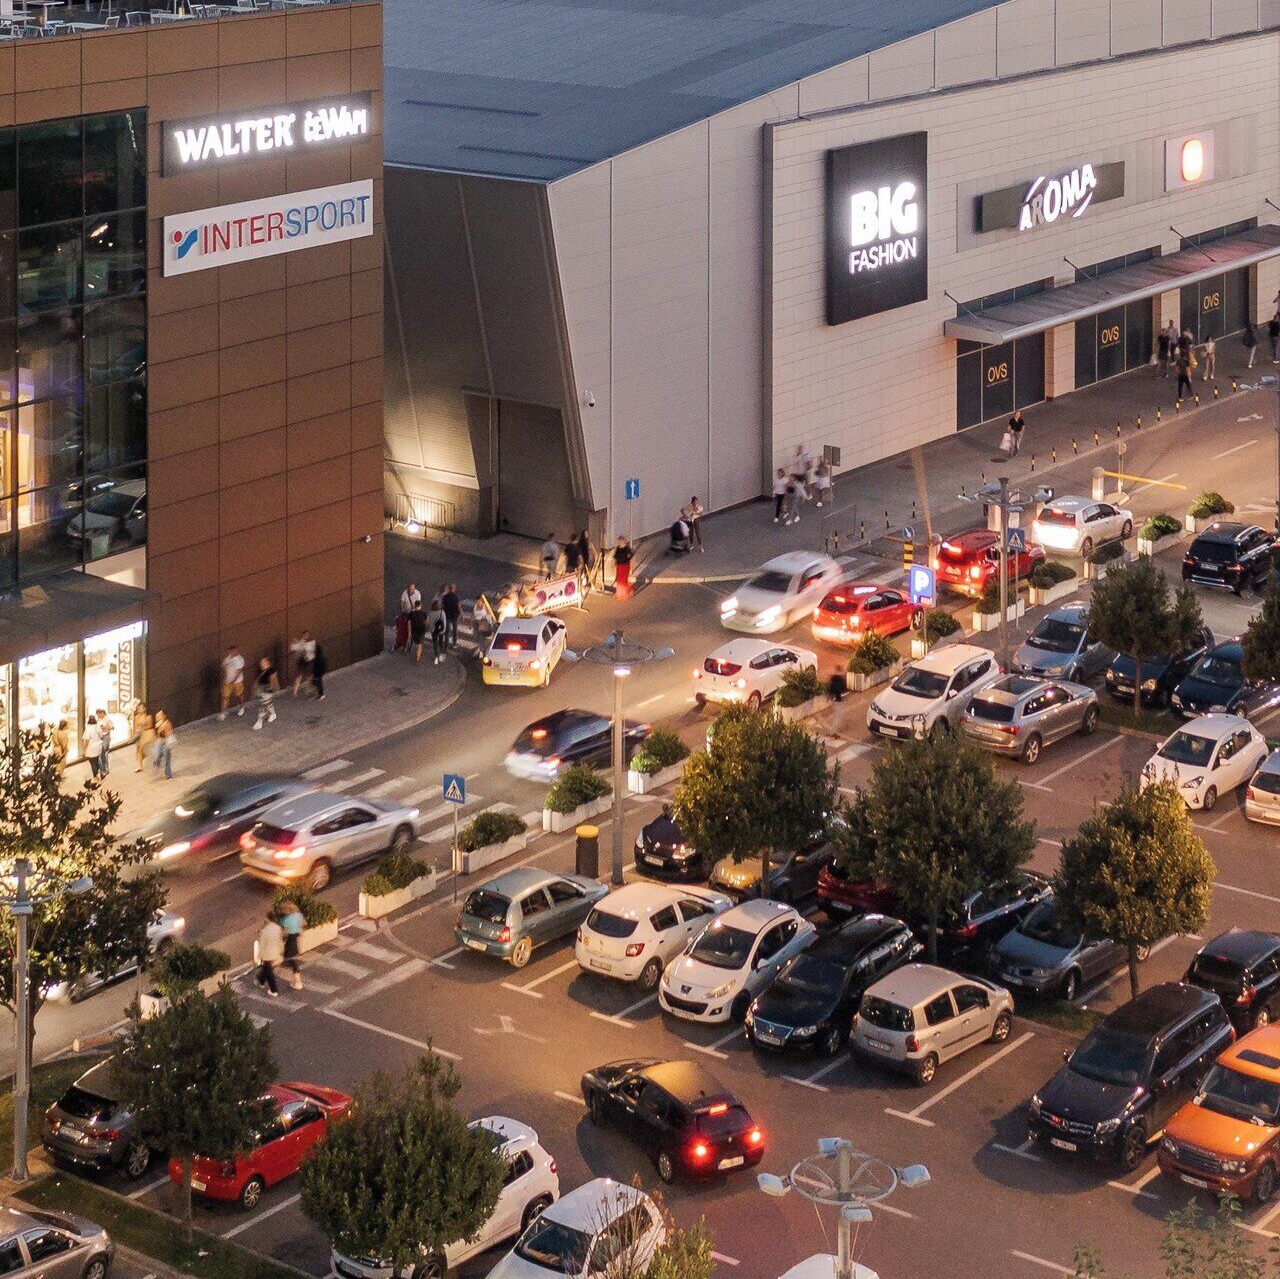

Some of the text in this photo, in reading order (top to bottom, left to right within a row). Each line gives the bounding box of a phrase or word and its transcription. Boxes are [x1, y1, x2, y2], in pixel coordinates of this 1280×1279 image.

[174, 112, 297, 163] WALTER
[850, 181, 918, 247] BIG
[1019, 163, 1097, 232] AROMA
[202, 195, 370, 255] INTERSPORT
[849, 236, 917, 275] FASHION
[1202, 292, 1220, 310] OVS
[1101, 325, 1120, 344] OVS
[987, 362, 1009, 383] OVS
[915, 570, 930, 592] P
